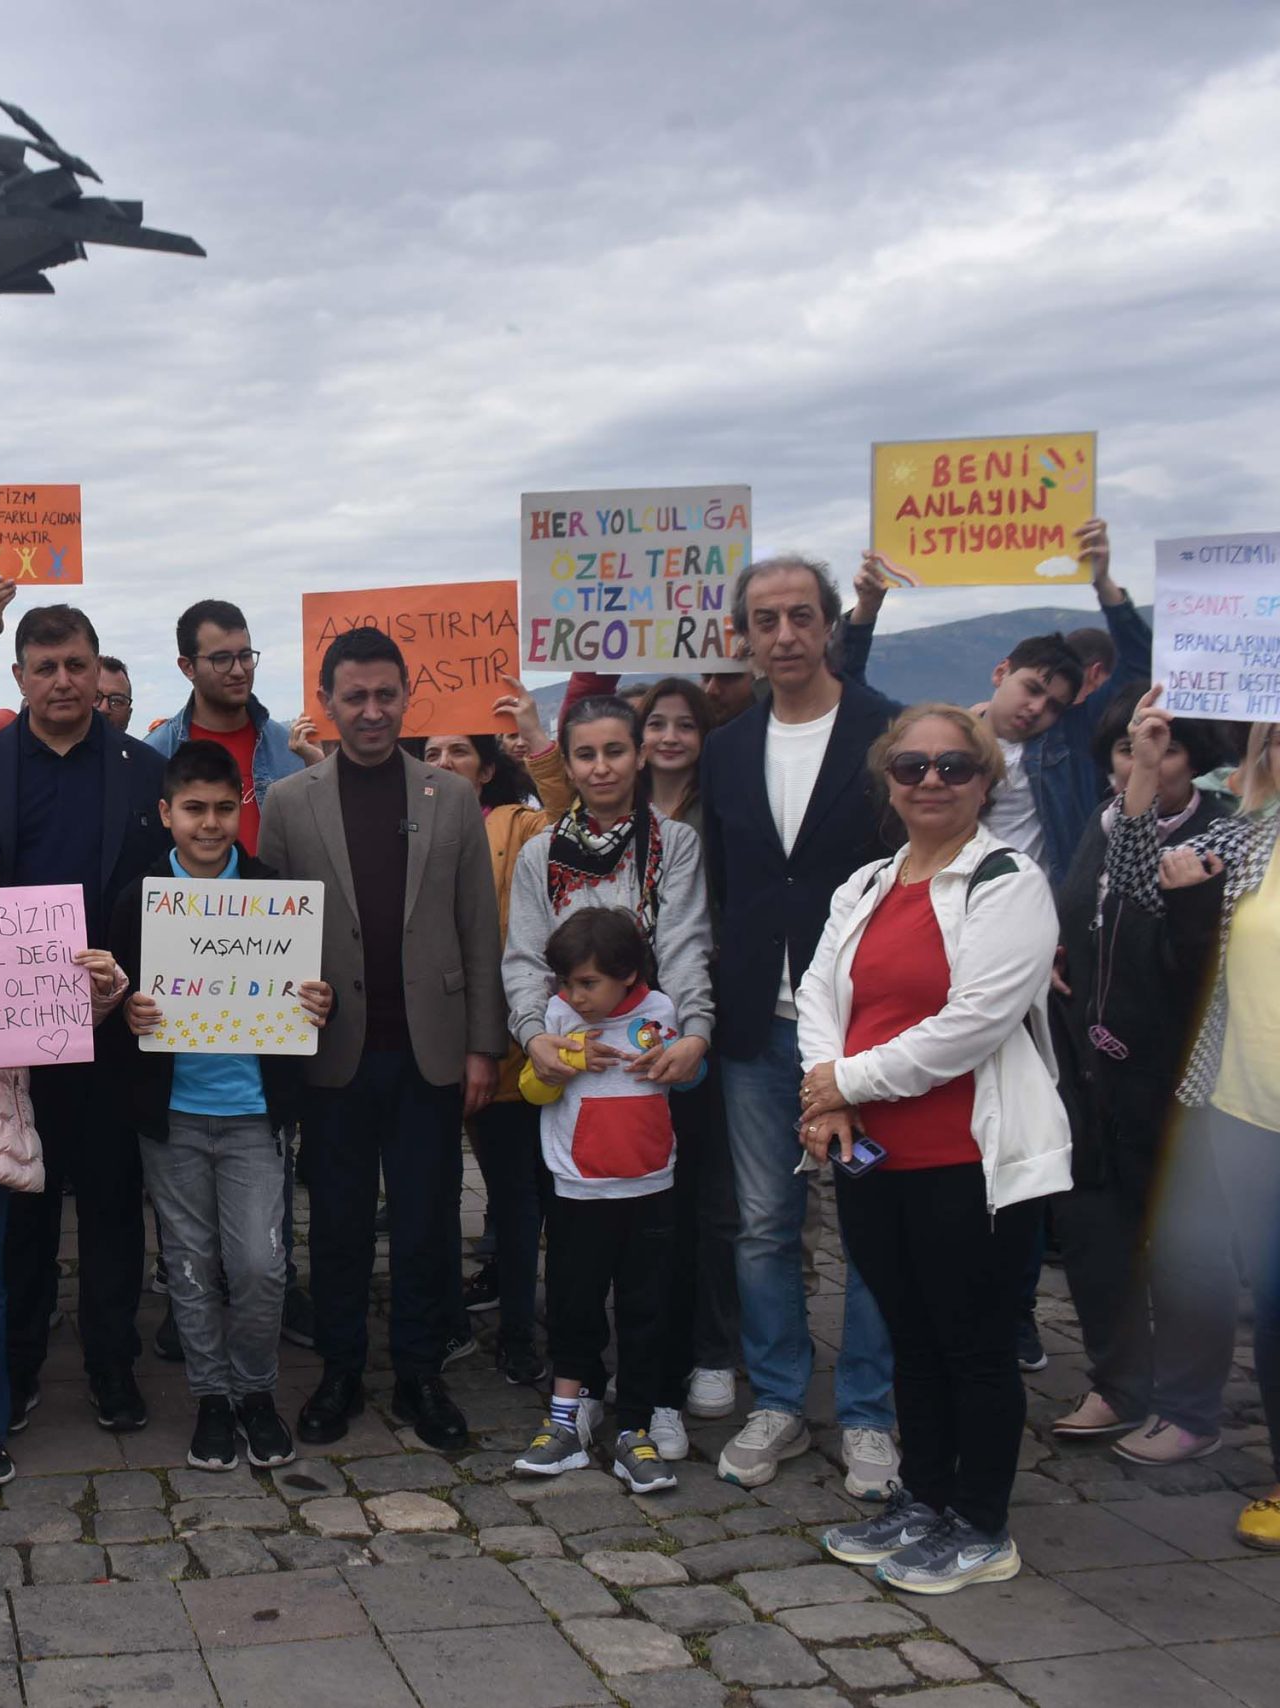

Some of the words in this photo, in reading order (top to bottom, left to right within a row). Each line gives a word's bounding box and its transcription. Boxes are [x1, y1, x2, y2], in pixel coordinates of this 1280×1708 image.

[932, 445, 1030, 487] BENİ
[42, 511, 81, 526] AÇIDAN
[895, 486, 1049, 521] ANLAYIN
[530, 510, 588, 540] HER
[596, 499, 748, 536] YOLCULUĞA
[909, 521, 1065, 556] İSTİYORUM
[550, 549, 634, 580] ÖZEL
[551, 582, 654, 612] OTİZM
[666, 580, 725, 615] İÇİN
[528, 615, 736, 663] ERGOTERAP
[1168, 671, 1228, 691] DEVLET
[146, 891, 314, 916] FARKLILIKLAR
[16, 940, 76, 966] DEĞİL
[189, 937, 292, 957] YAŞAMIN
[5, 973, 89, 998] OLMAK
